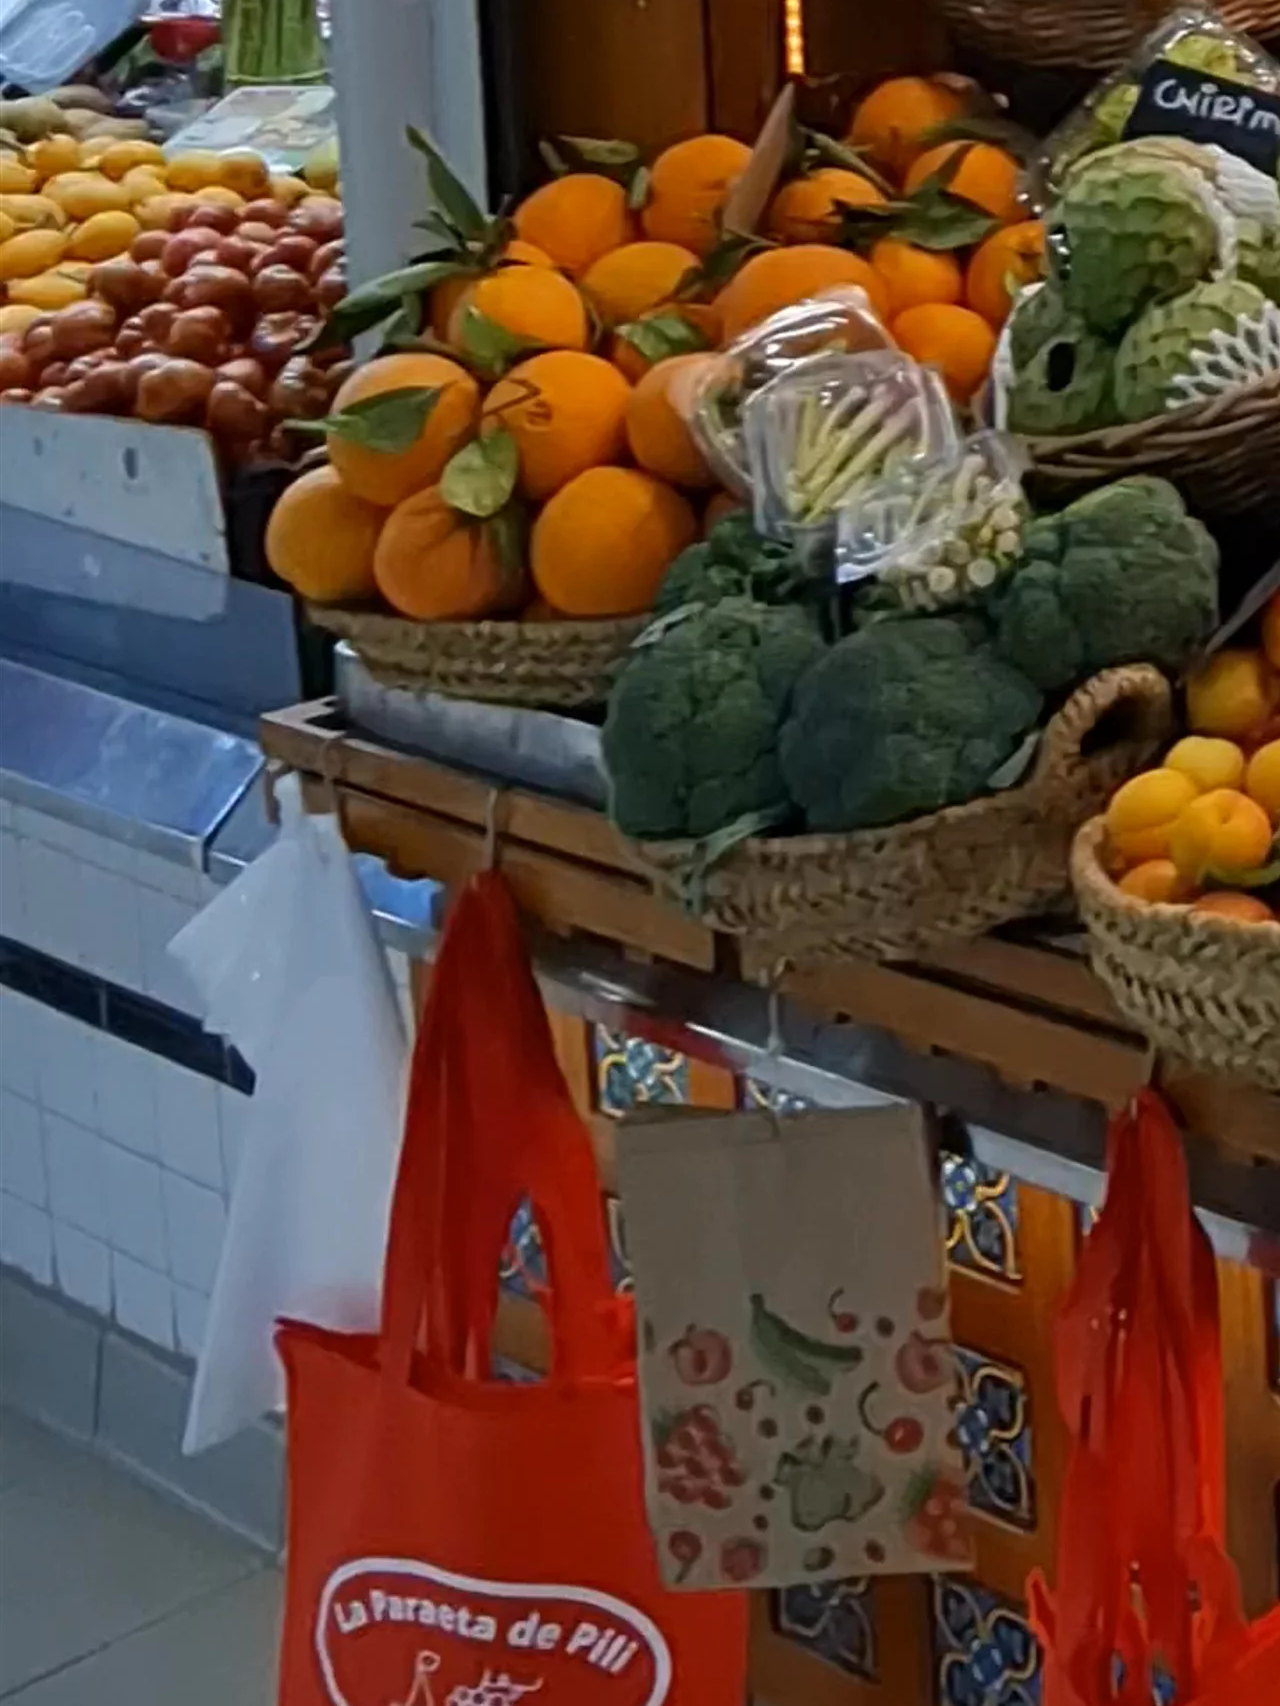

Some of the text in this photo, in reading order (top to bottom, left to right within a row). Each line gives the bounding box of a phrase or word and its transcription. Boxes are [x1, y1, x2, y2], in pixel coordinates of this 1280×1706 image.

[333, 1588, 640, 1675] La Paraeta de Pili
